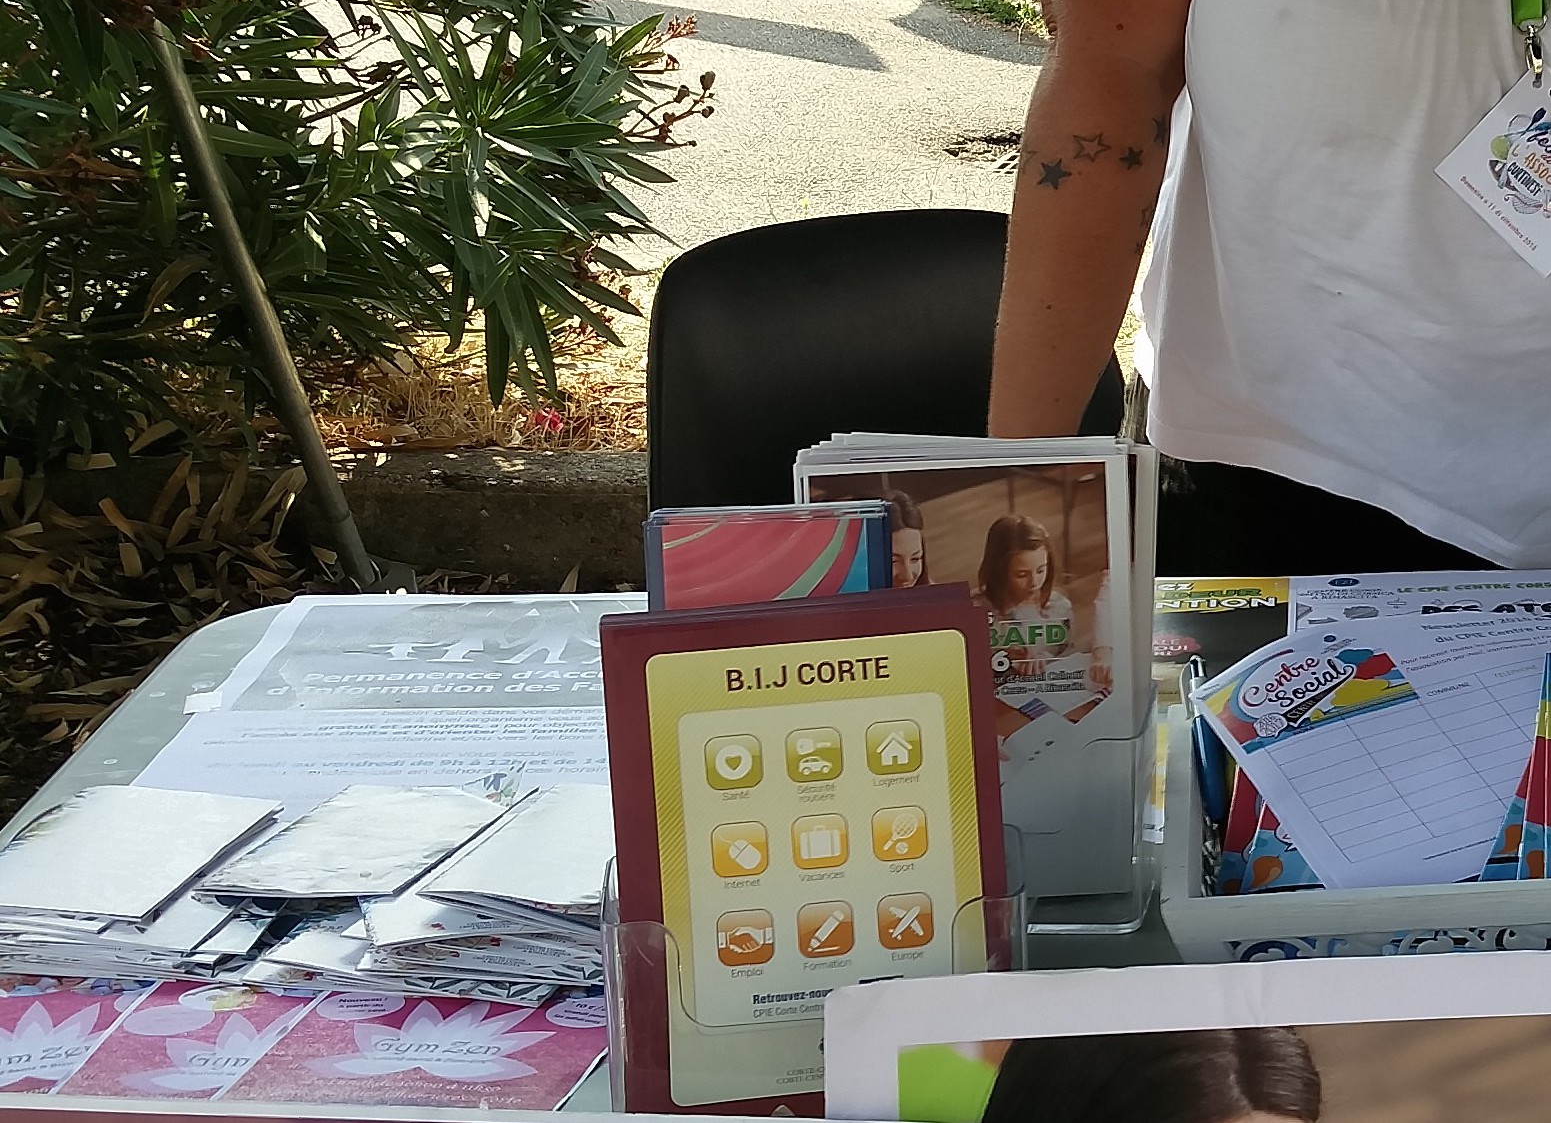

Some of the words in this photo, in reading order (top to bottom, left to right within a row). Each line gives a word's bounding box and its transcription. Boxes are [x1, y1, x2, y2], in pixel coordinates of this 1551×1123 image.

[512, 668, 603, 681] d'Acc
[725, 665, 788, 692] B.I.J
[797, 656, 890, 686] CORTE
[504, 682, 562, 693] des
[1242, 656, 1320, 707] Centre
[1268, 658, 1355, 709] Social
[873, 774, 920, 789] Logement
[722, 789, 750, 802] Santé
[889, 862, 915, 875] Sport
[723, 878, 761, 889] Internet
[891, 950, 925, 963] Europe
[803, 958, 851, 971] Formation
[731, 967, 764, 979] Emploi
[374, 1038, 440, 1055] Gym
[444, 1039, 502, 1057] Zen
